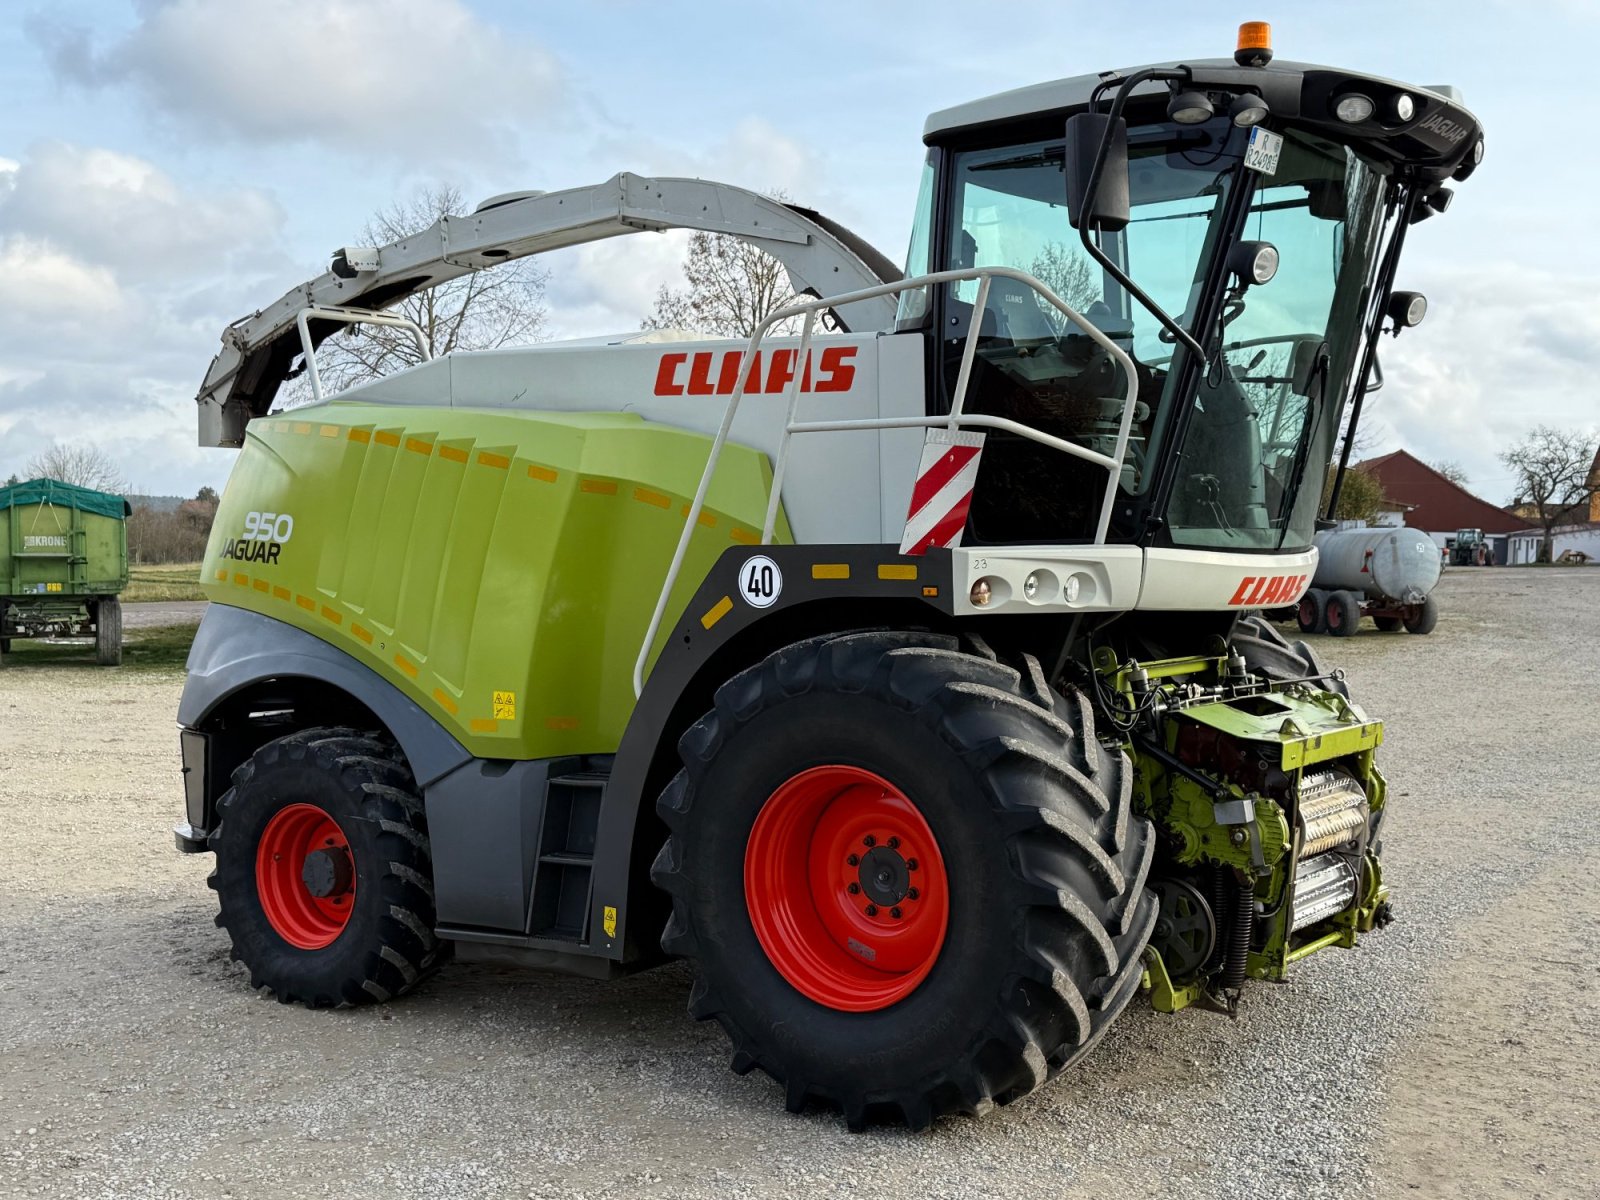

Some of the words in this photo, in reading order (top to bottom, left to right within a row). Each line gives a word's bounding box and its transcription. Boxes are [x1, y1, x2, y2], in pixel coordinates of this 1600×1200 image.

[1261, 134, 1270, 151] R
[1419, 114, 1468, 144] JAGUAR
[1251, 150, 1273, 171] 2498
[1005, 294, 1023, 304] CLAAS
[654, 346, 859, 396] CLAAS
[242, 511, 293, 543] 950
[220, 538, 281, 565] JAGUAR
[973, 558, 987, 570] 23
[747, 565, 774, 598] 40
[1228, 574, 1307, 605] CLAAS
